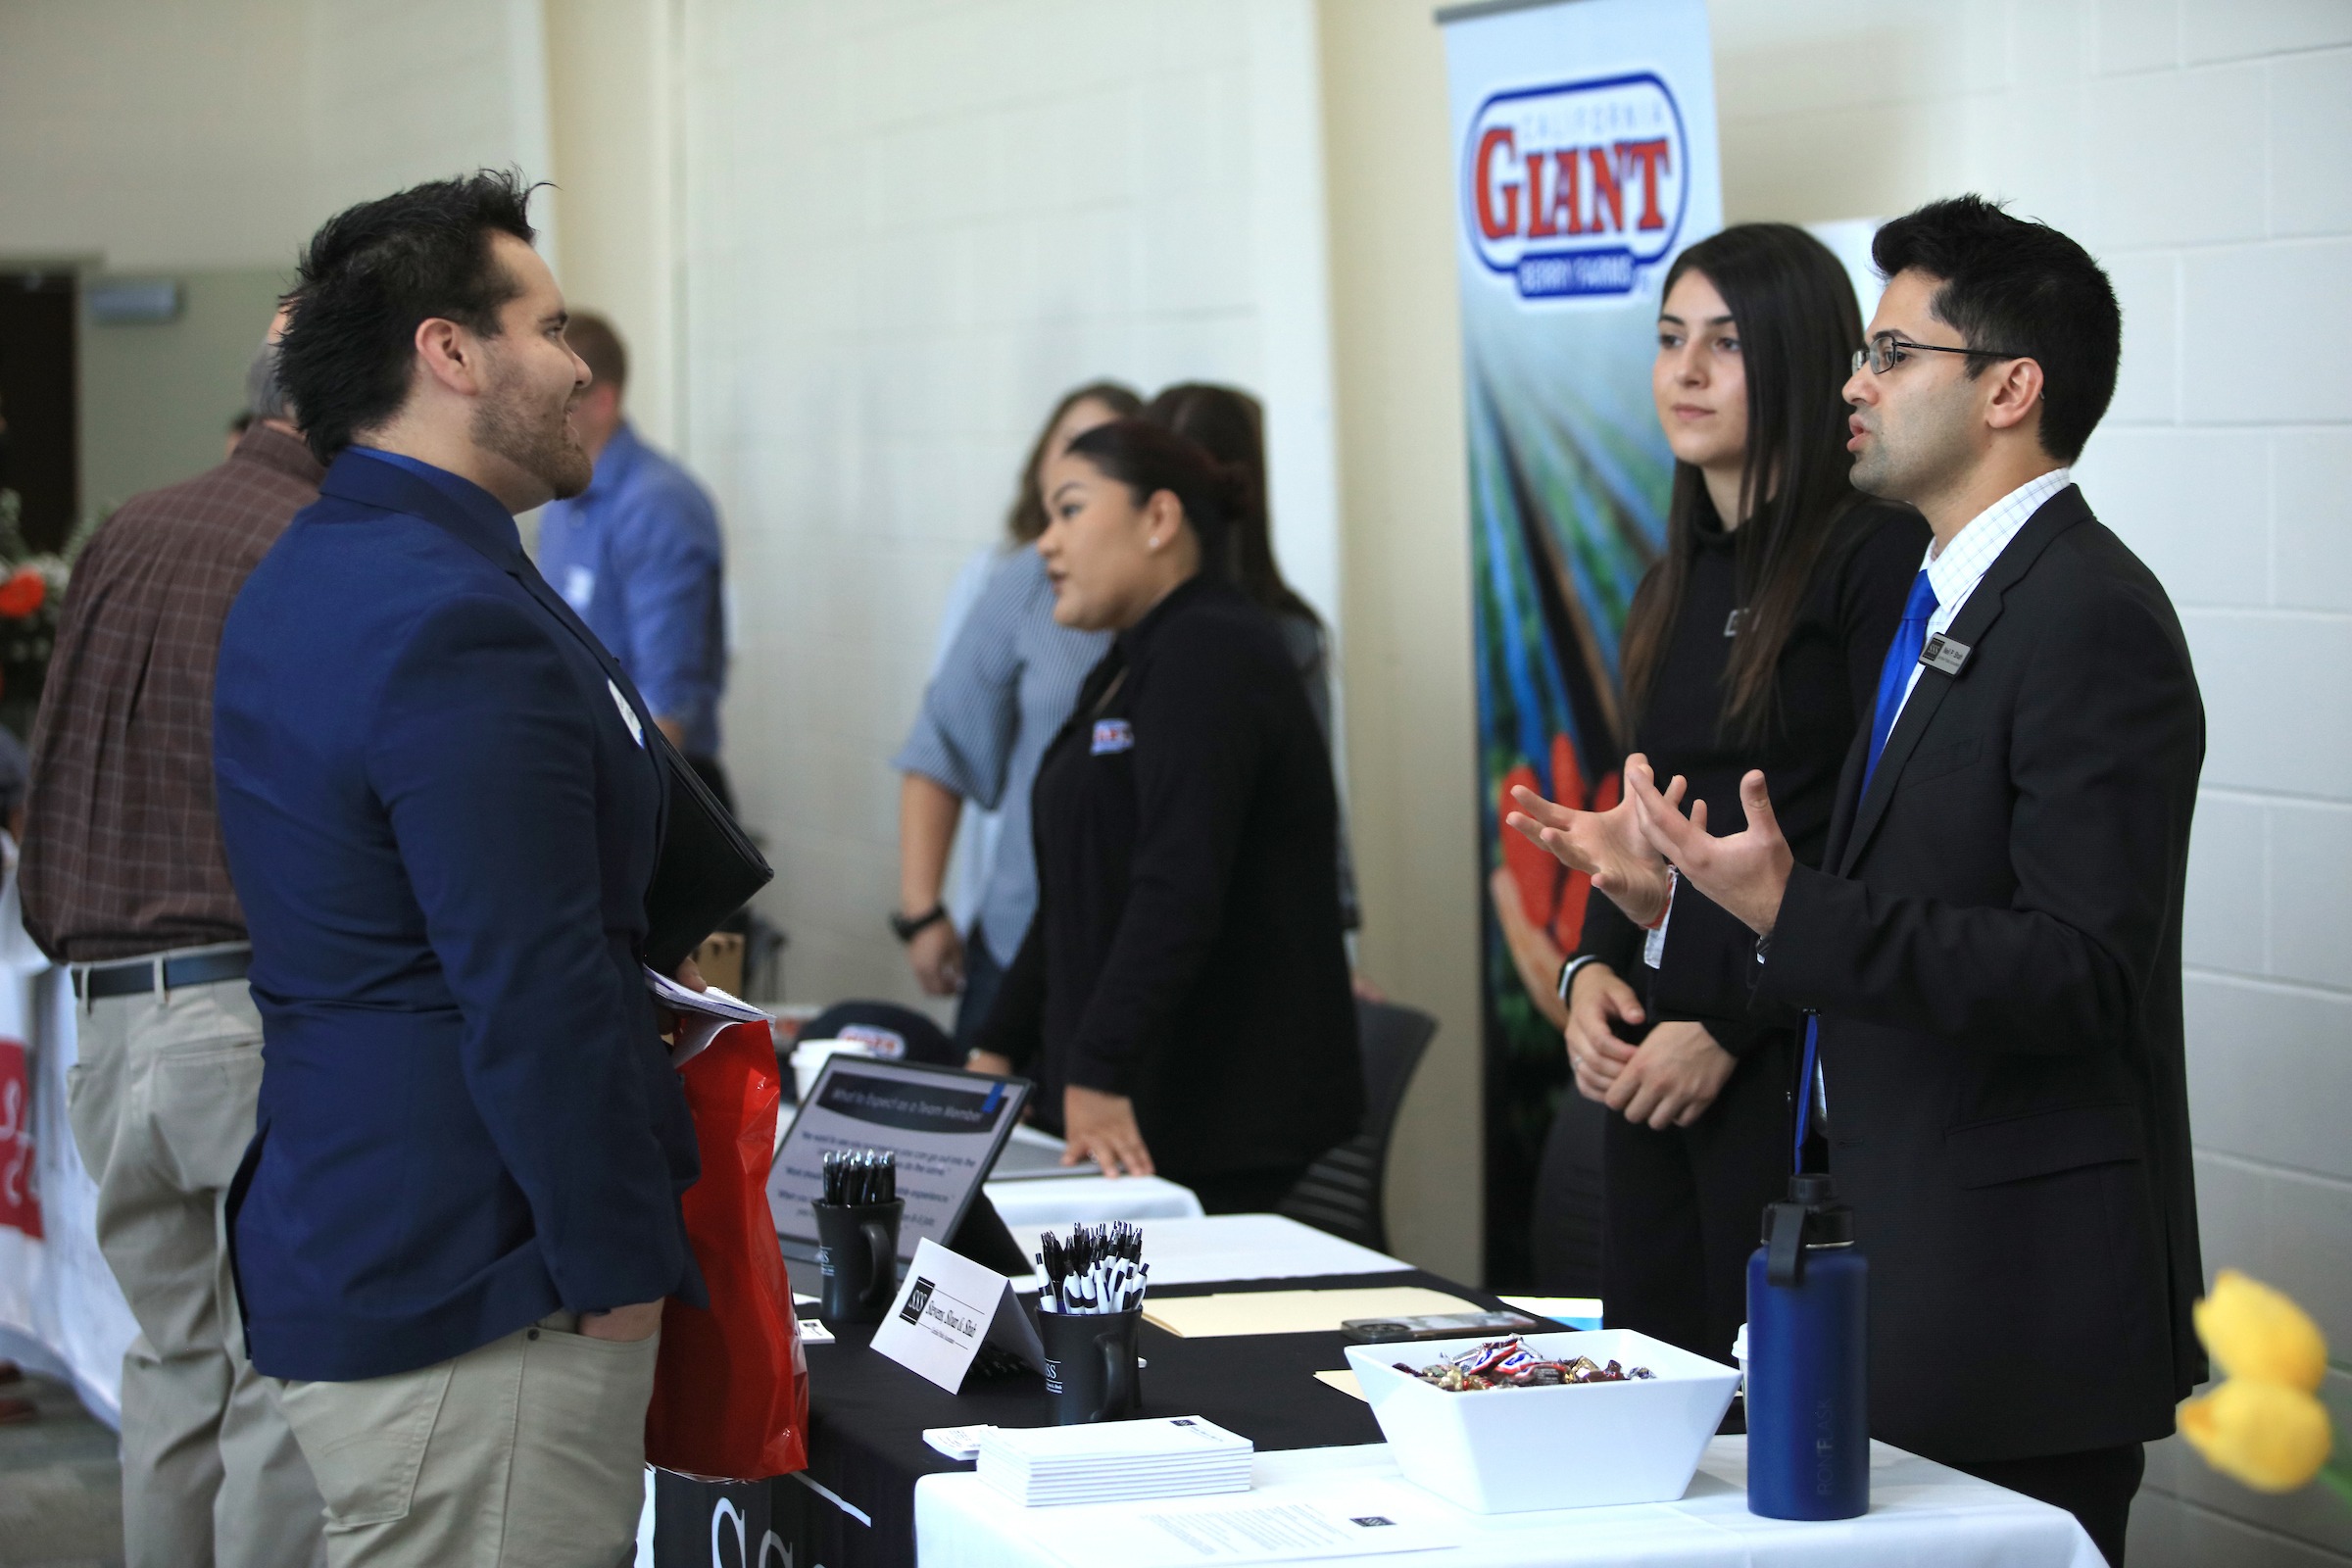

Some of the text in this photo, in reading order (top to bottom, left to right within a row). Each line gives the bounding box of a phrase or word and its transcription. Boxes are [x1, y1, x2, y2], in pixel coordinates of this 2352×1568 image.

[917, 1099, 943, 1116] Team
[943, 1103, 982, 1122] Member
[907, 1289, 928, 1312] SSS
